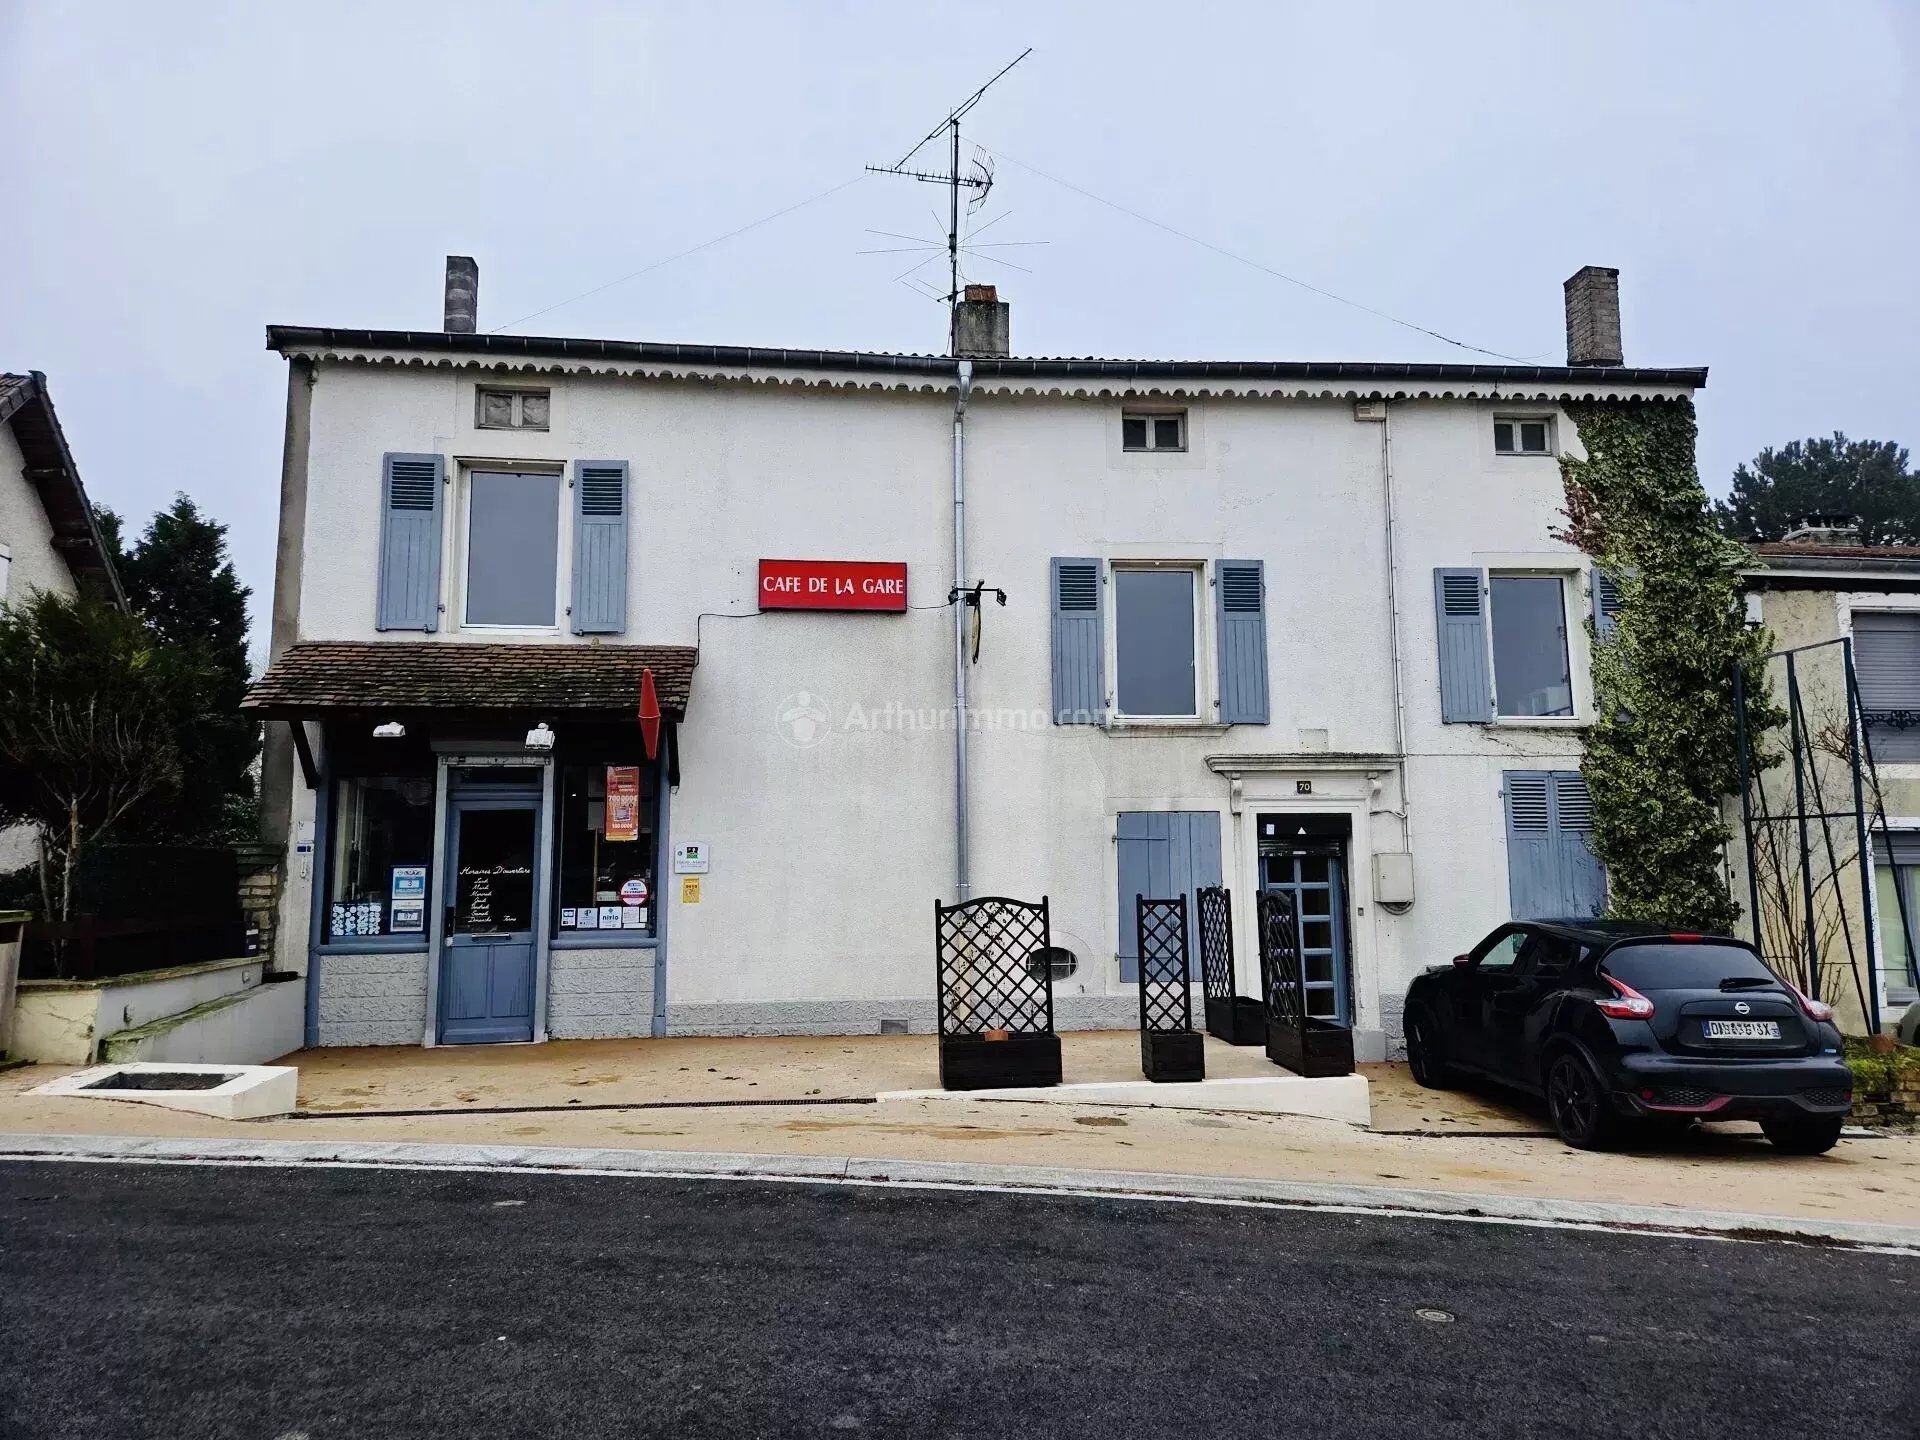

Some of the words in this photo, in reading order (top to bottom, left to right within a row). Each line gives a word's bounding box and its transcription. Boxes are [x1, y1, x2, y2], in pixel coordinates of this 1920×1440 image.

[763, 576, 801, 592] CAFE
[808, 577, 828, 593] DE
[835, 578, 855, 595] LA
[862, 578, 904, 594] GARE
[1299, 783, 1310, 791] 70
